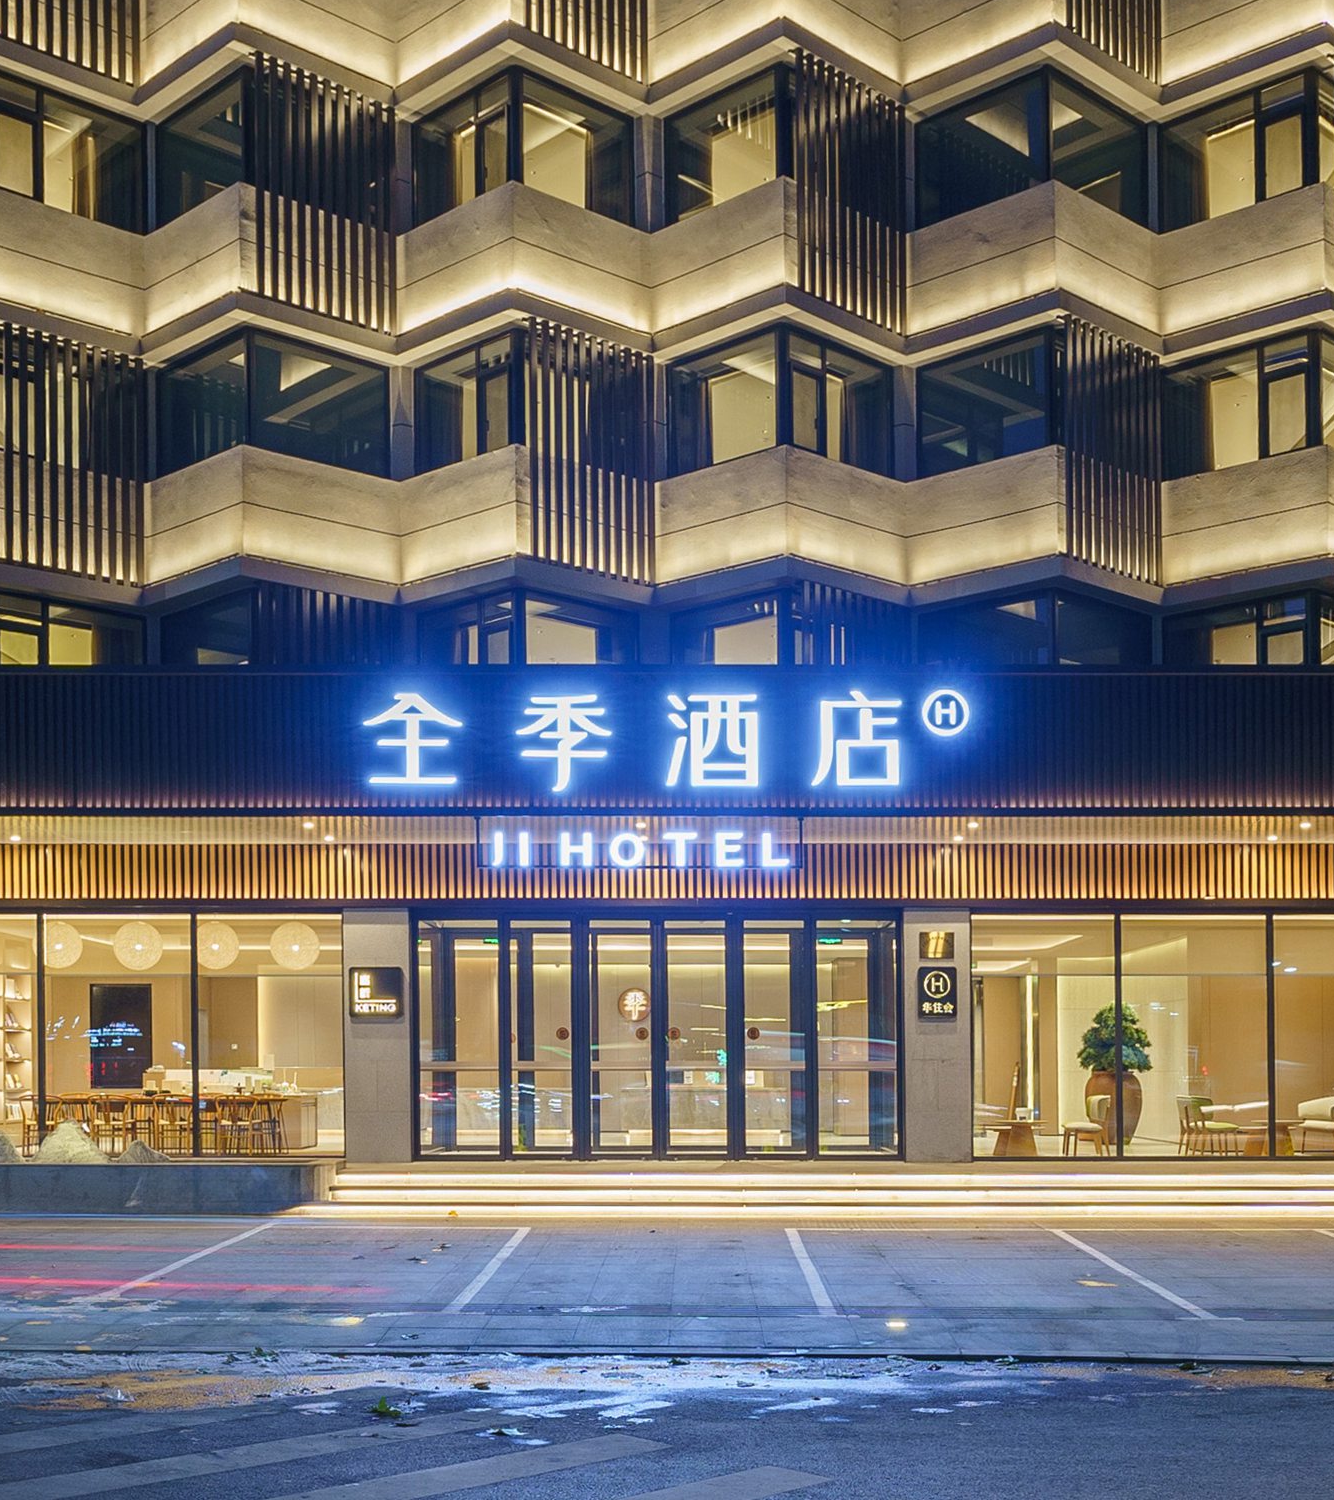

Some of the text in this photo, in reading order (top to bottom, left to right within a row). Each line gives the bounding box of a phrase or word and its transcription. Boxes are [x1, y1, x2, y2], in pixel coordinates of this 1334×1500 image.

[363, 690, 903, 792] 全季酒店
[492, 831, 789, 868] JI HOTEL
[355, 1003, 397, 1013] KETING
[922, 1002, 954, 1014] 华住会
